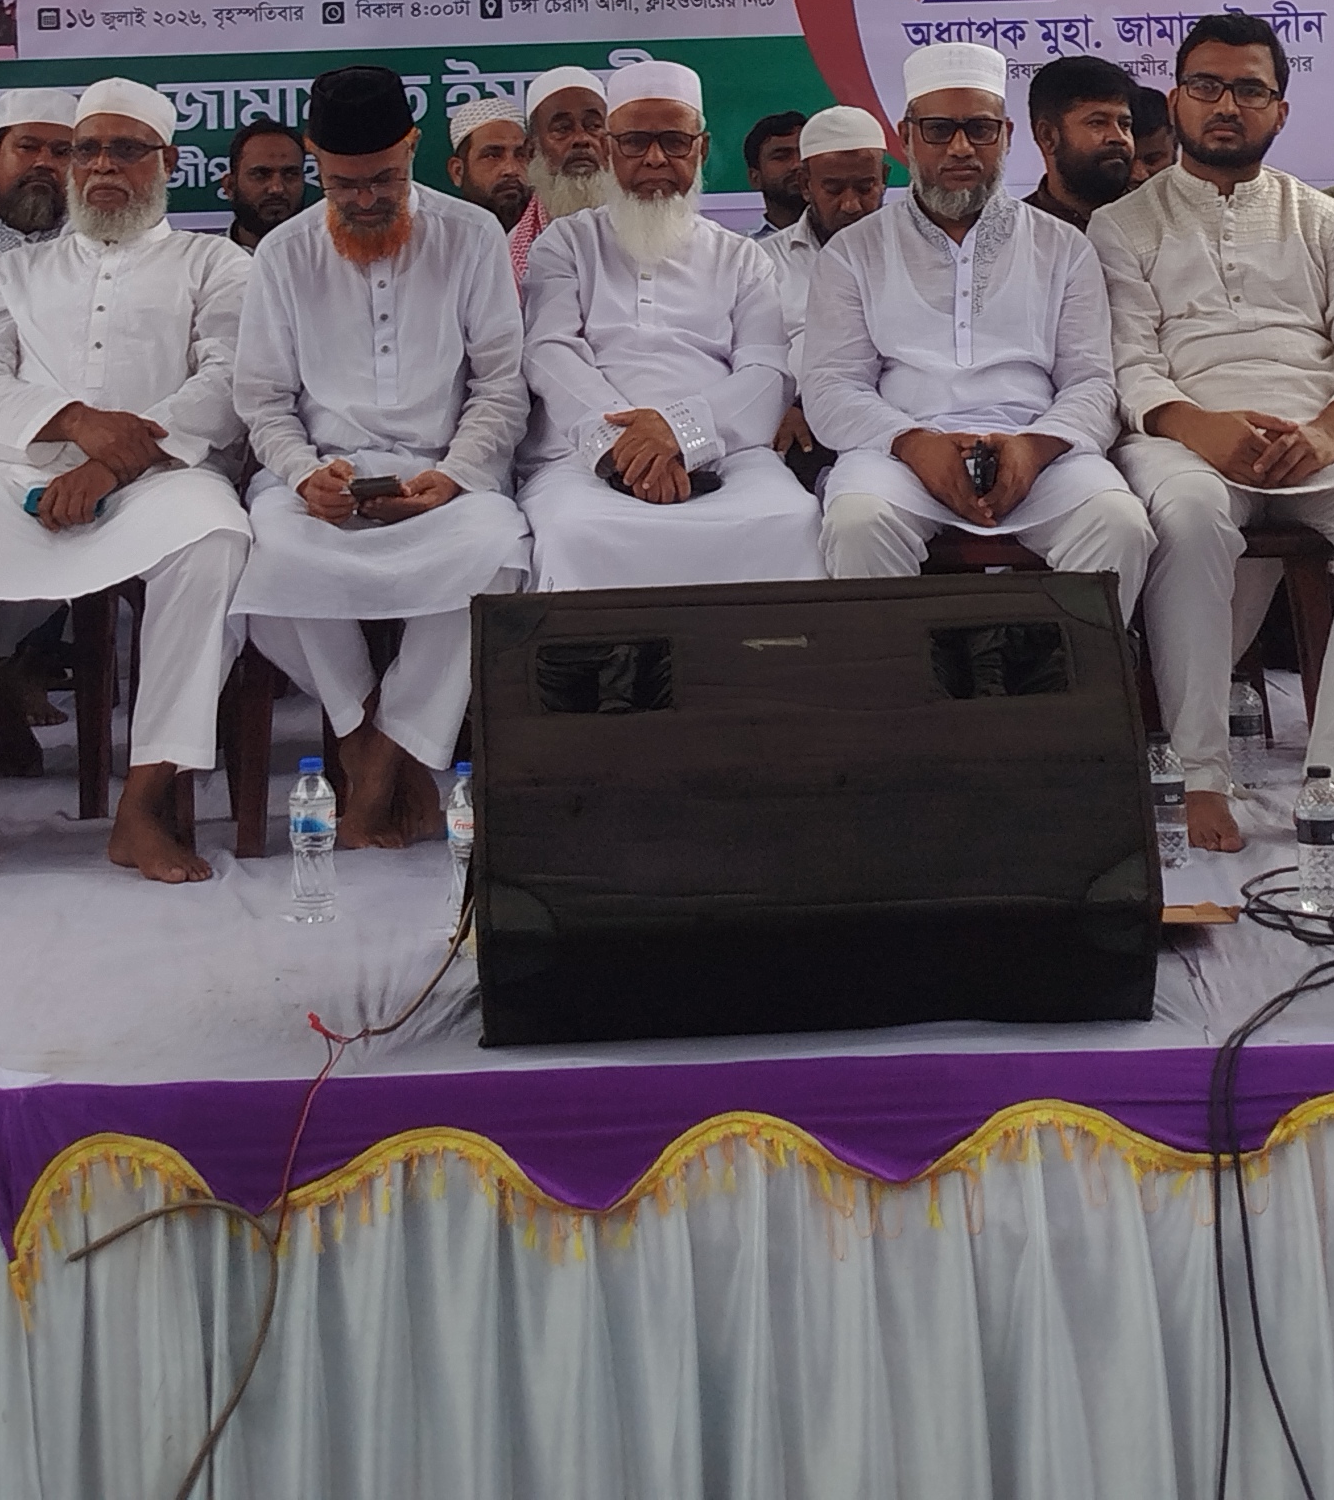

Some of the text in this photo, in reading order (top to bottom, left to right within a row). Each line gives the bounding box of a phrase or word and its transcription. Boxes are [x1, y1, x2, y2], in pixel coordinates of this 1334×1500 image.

[65, 2, 304, 31] ১৬ জুলাই ২০২৬, বৃহস্পতিবার
[355, 0, 405, 20] বিকাল
[901, 16, 1029, 50] অধ্যাপক
[1035, 13, 1102, 56] মুহা.
